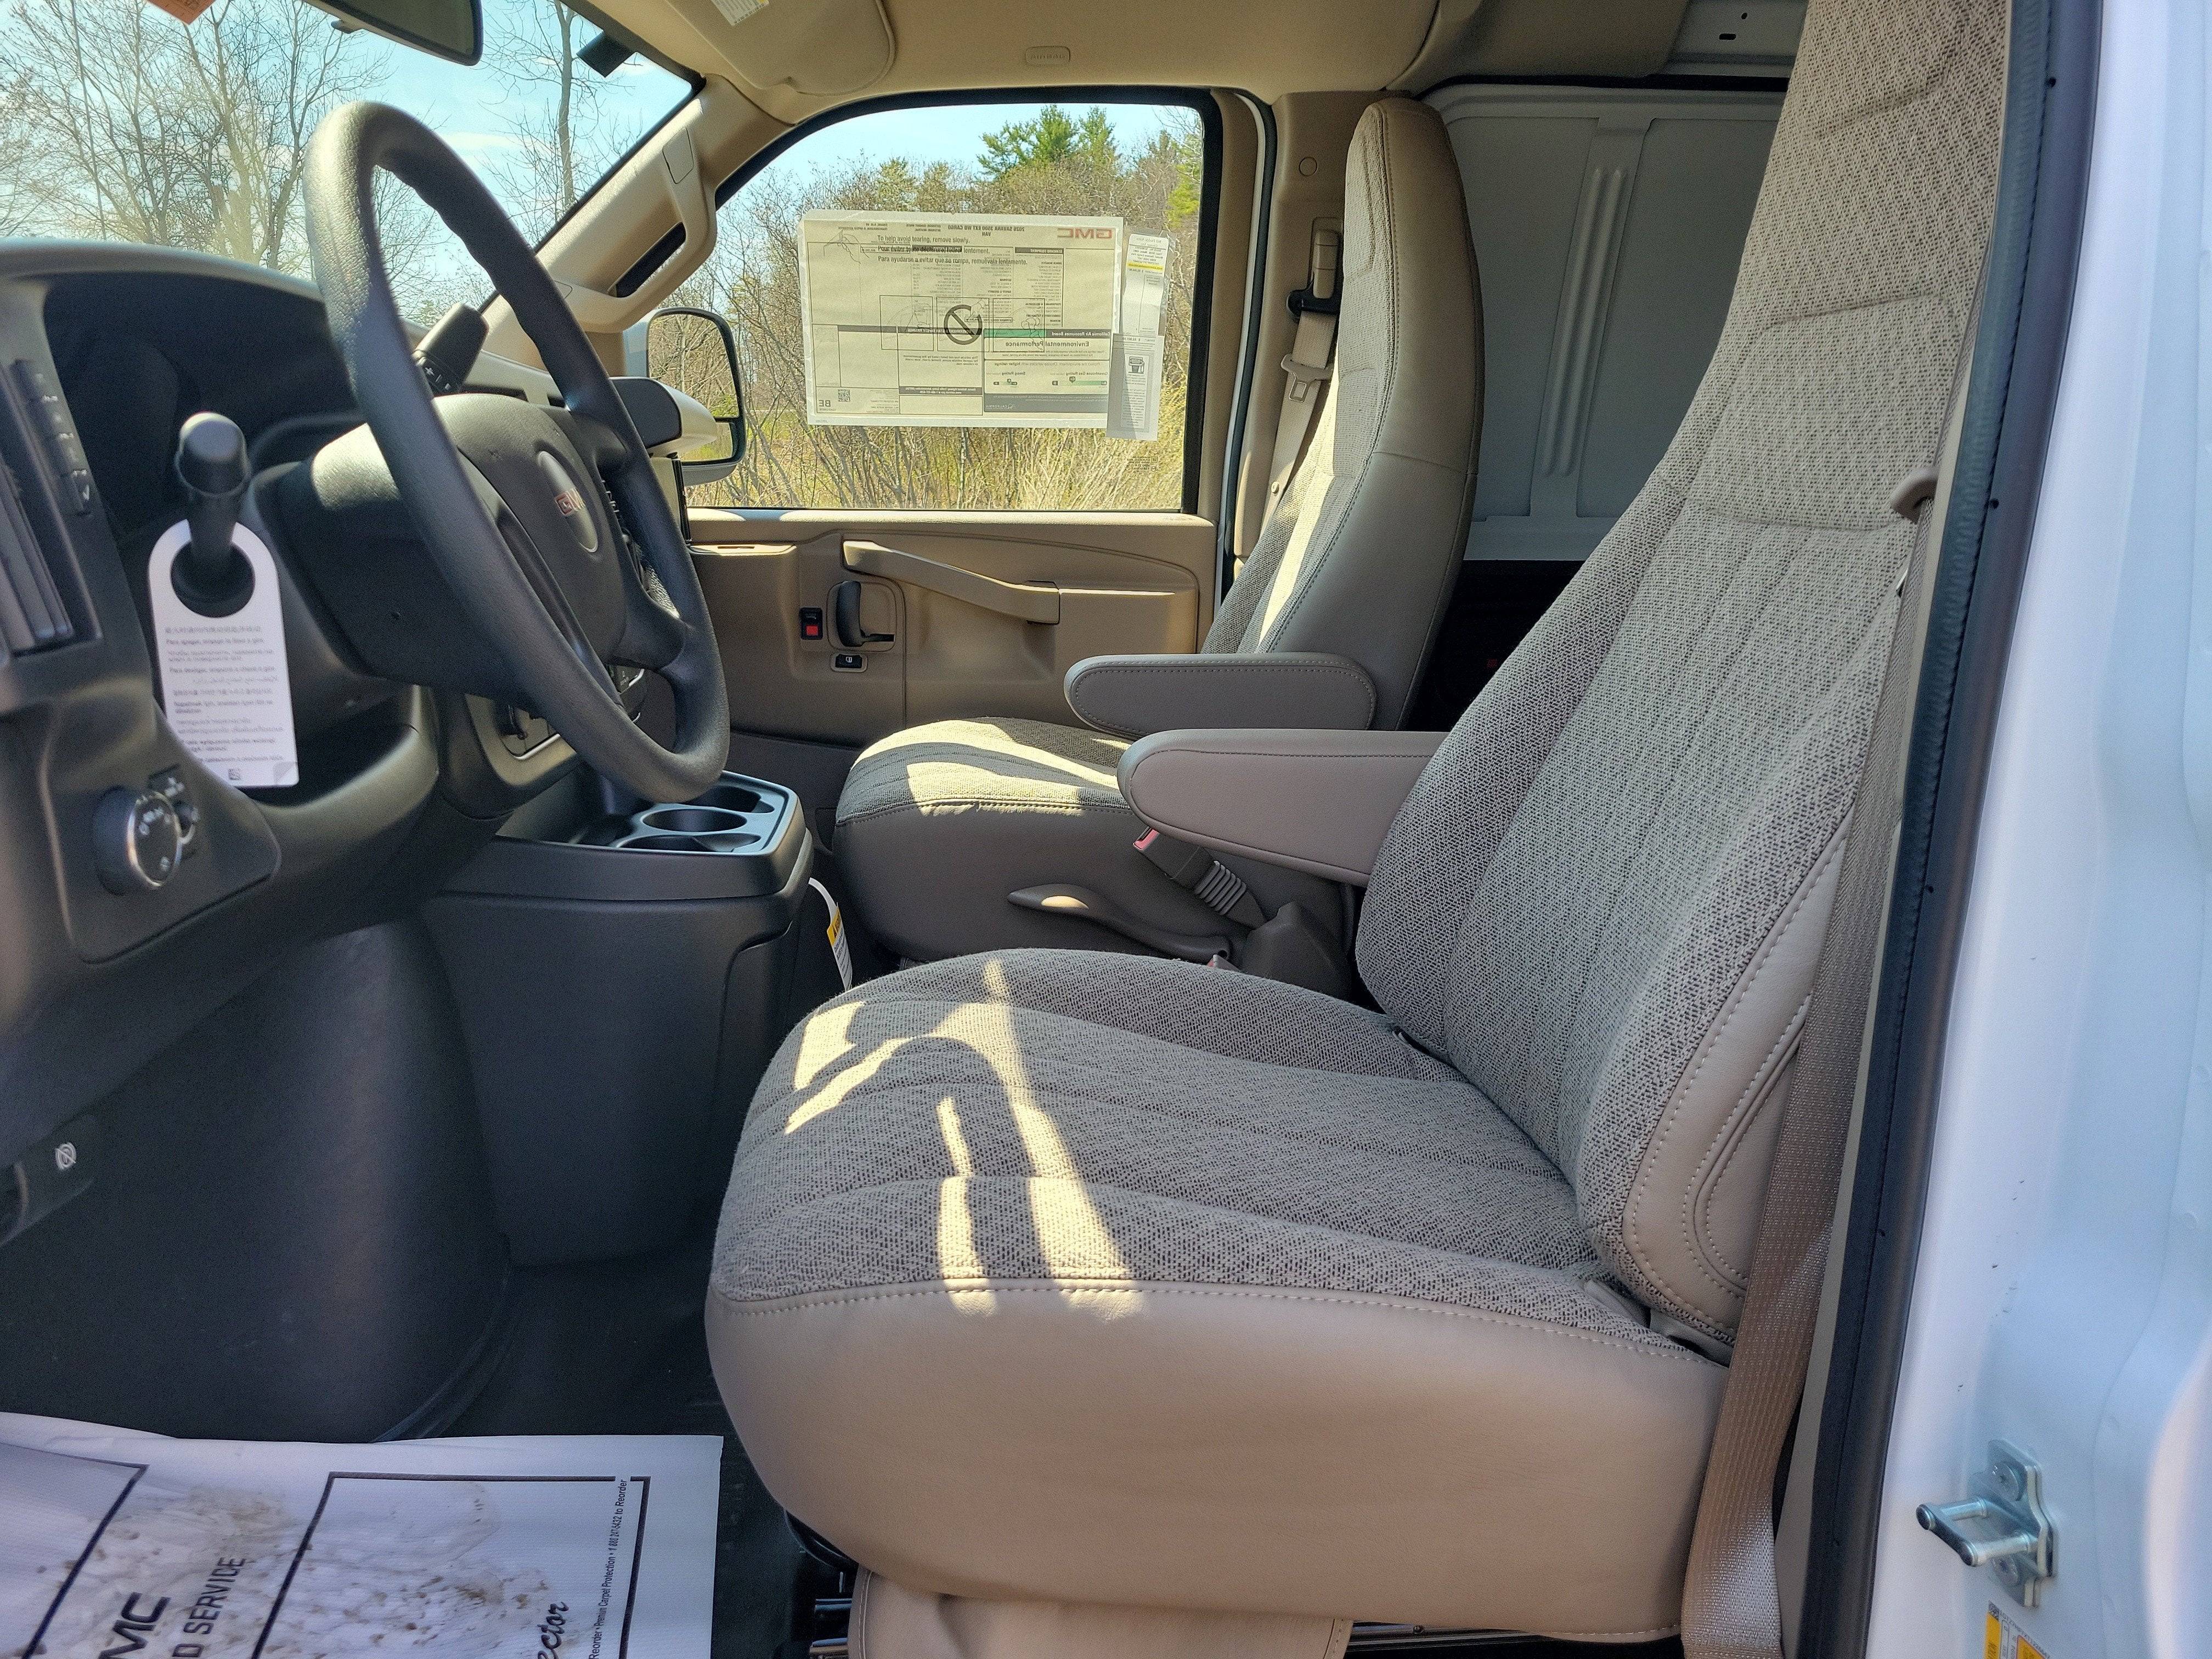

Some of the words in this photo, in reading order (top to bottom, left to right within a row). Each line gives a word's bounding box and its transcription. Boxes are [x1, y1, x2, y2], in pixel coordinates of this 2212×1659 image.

[615, 1479, 628, 1506] Reorder
[602, 1556, 616, 1588] Protection
[183, 1557, 246, 1635] SERVICE
[598, 1588, 612, 1607] Carpet
[594, 1607, 607, 1627] Premium
